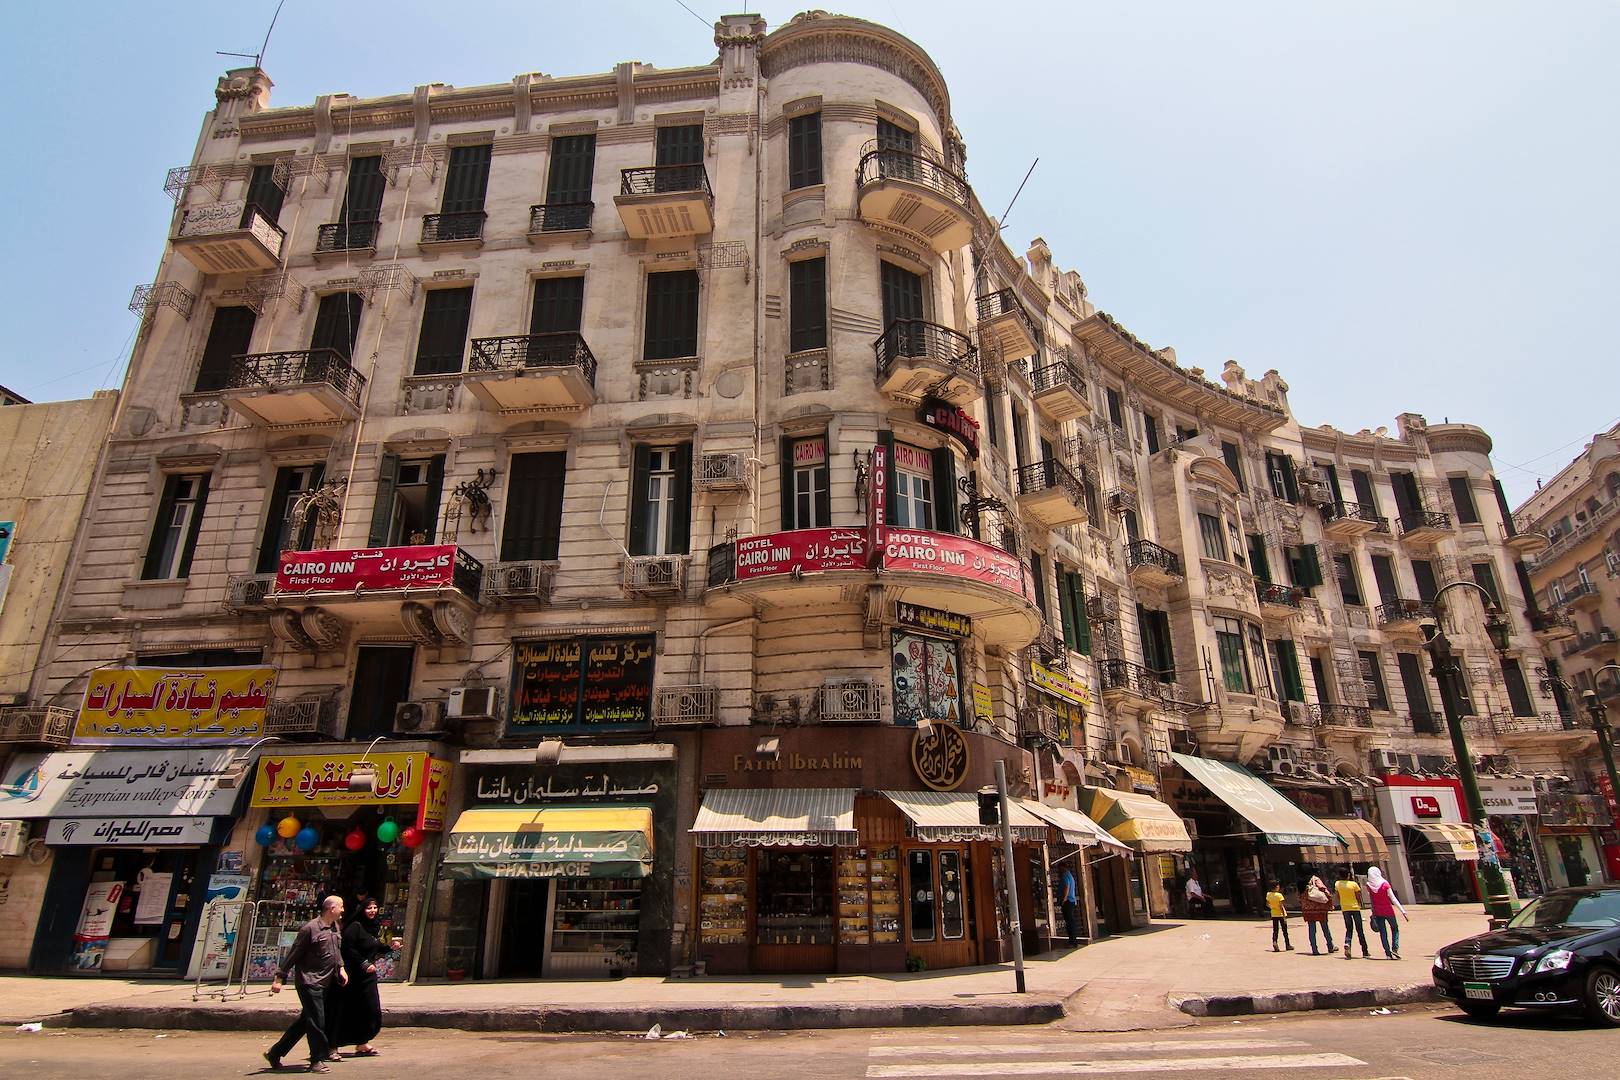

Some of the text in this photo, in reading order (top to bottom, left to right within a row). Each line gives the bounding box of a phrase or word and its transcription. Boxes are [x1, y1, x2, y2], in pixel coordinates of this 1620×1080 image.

[796, 442, 813, 461] CAIRO
[896, 445, 929, 470] AIRO INN
[875, 451, 884, 545] HOTEL
[740, 539, 773, 551] HOTEL
[889, 533, 939, 546] HOTEL
[351, 551, 383, 560] فندق
[738, 547, 791, 567] CAIRO INN
[886, 544, 965, 566] CAIRO INN
[283, 562, 355, 575] CAIRO INN
[929, 564, 945, 572] Floor
[555, 642, 580, 667] قيادة
[589, 643, 618, 667] تعليم
[620, 640, 652, 665] مركز
[87, 679, 274, 721] تعليم قيادة السيارات
[183, 723, 225, 737] كار
[228, 721, 259, 735] نور
[57, 763, 128, 784] للسياحة
[65, 787, 129, 807] Egyptian
[174, 785, 216, 800] Tours
[477, 774, 659, 804] صيدلية سليمان باشا
[93, 820, 184, 842] مصر للطيران
[457, 833, 628, 859] صيدلية سليمان باشا
